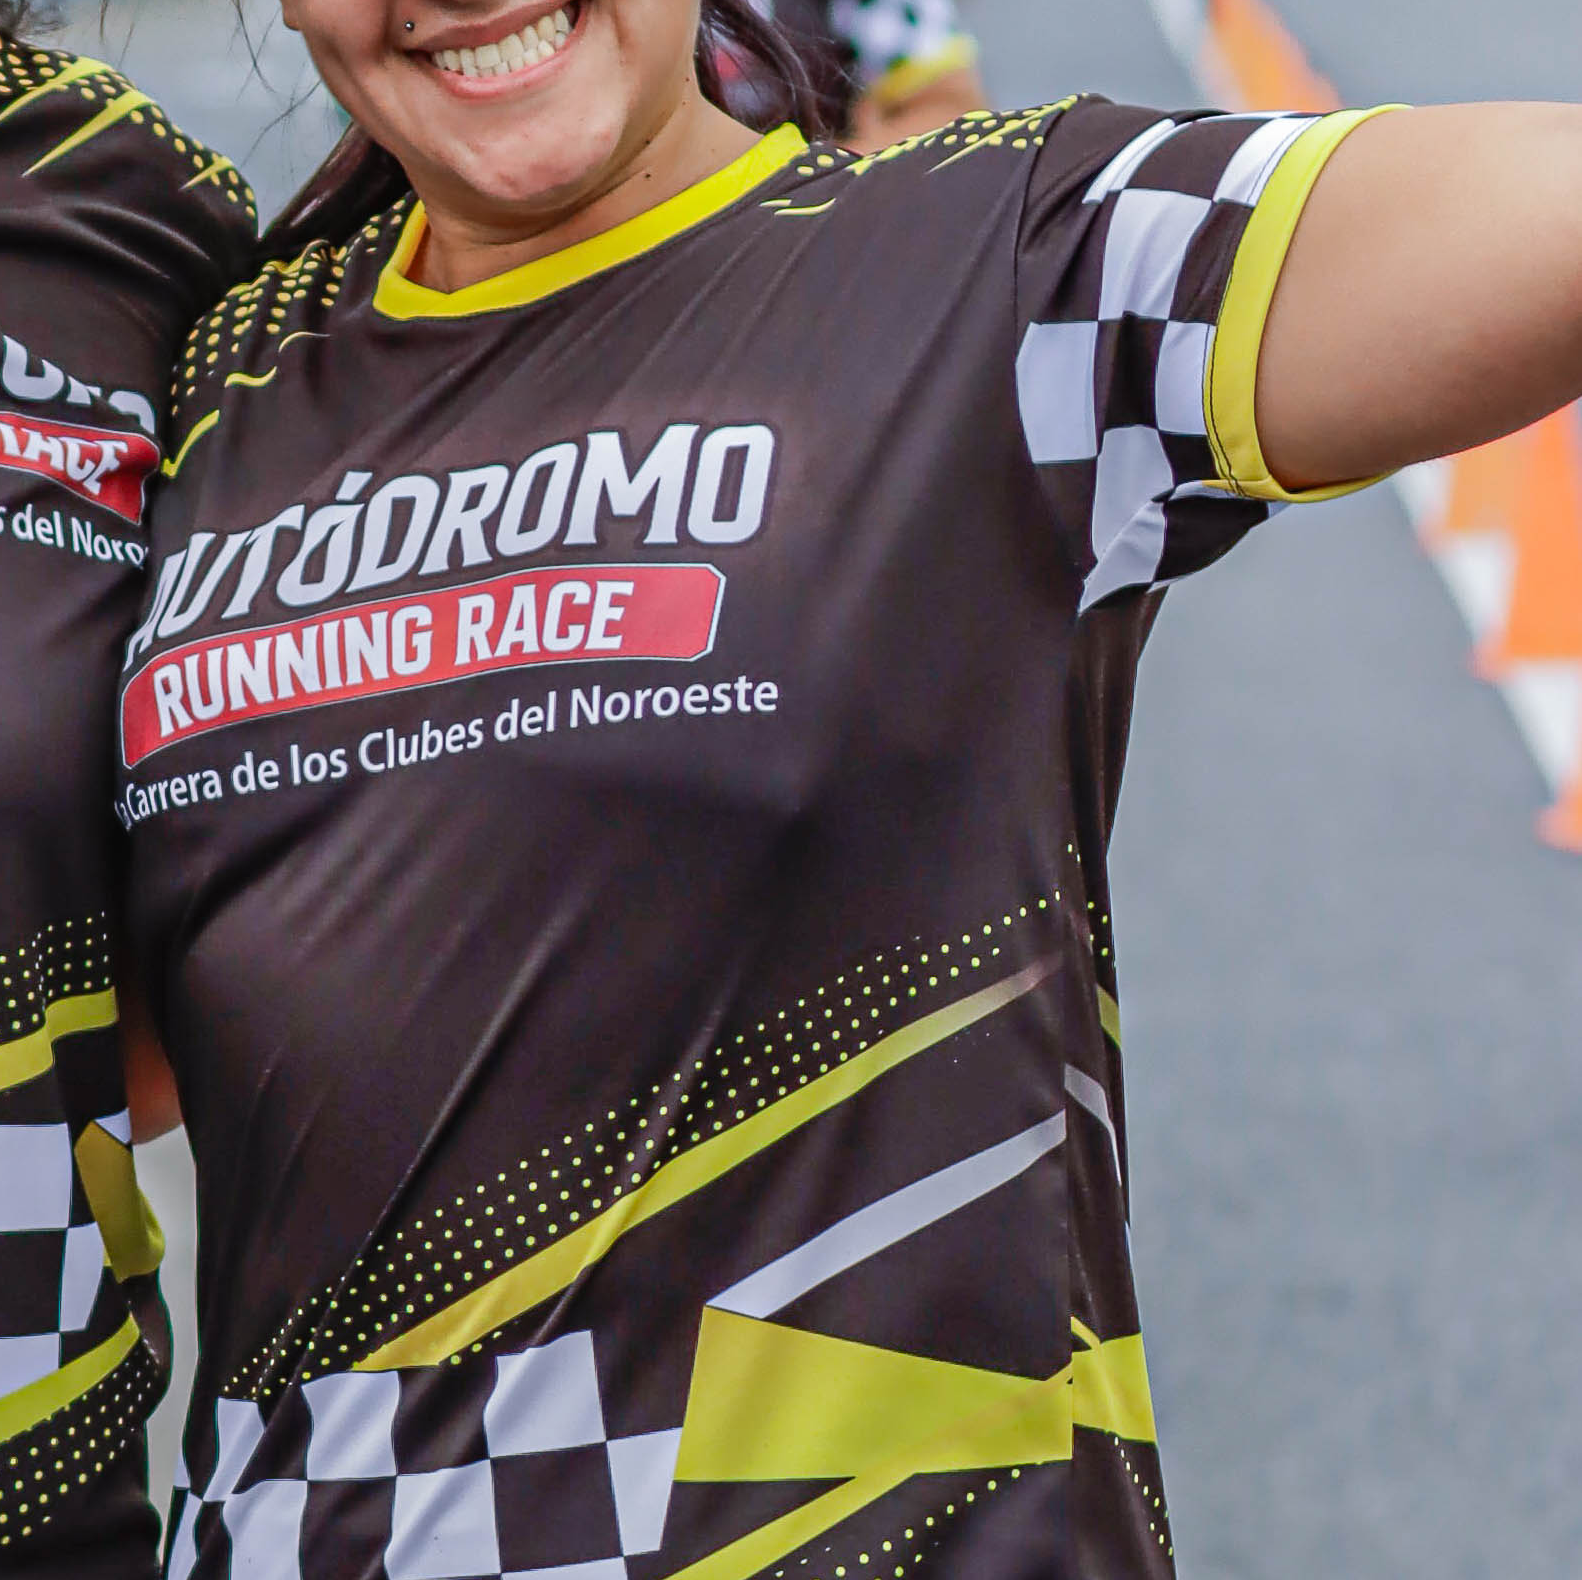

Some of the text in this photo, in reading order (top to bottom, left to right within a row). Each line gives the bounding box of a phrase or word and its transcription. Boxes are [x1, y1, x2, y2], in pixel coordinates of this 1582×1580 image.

[11, 503, 65, 549] del
[71, 517, 150, 570] Noro
[123, 423, 776, 673] AUTÓDROMO
[152, 580, 635, 739] RUNNING RACE
[125, 768, 223, 821] Carrera
[231, 750, 280, 795] de
[290, 744, 348, 783] los
[358, 720, 484, 771] Clubes
[493, 691, 557, 743] del
[568, 675, 780, 729] Noroeste
